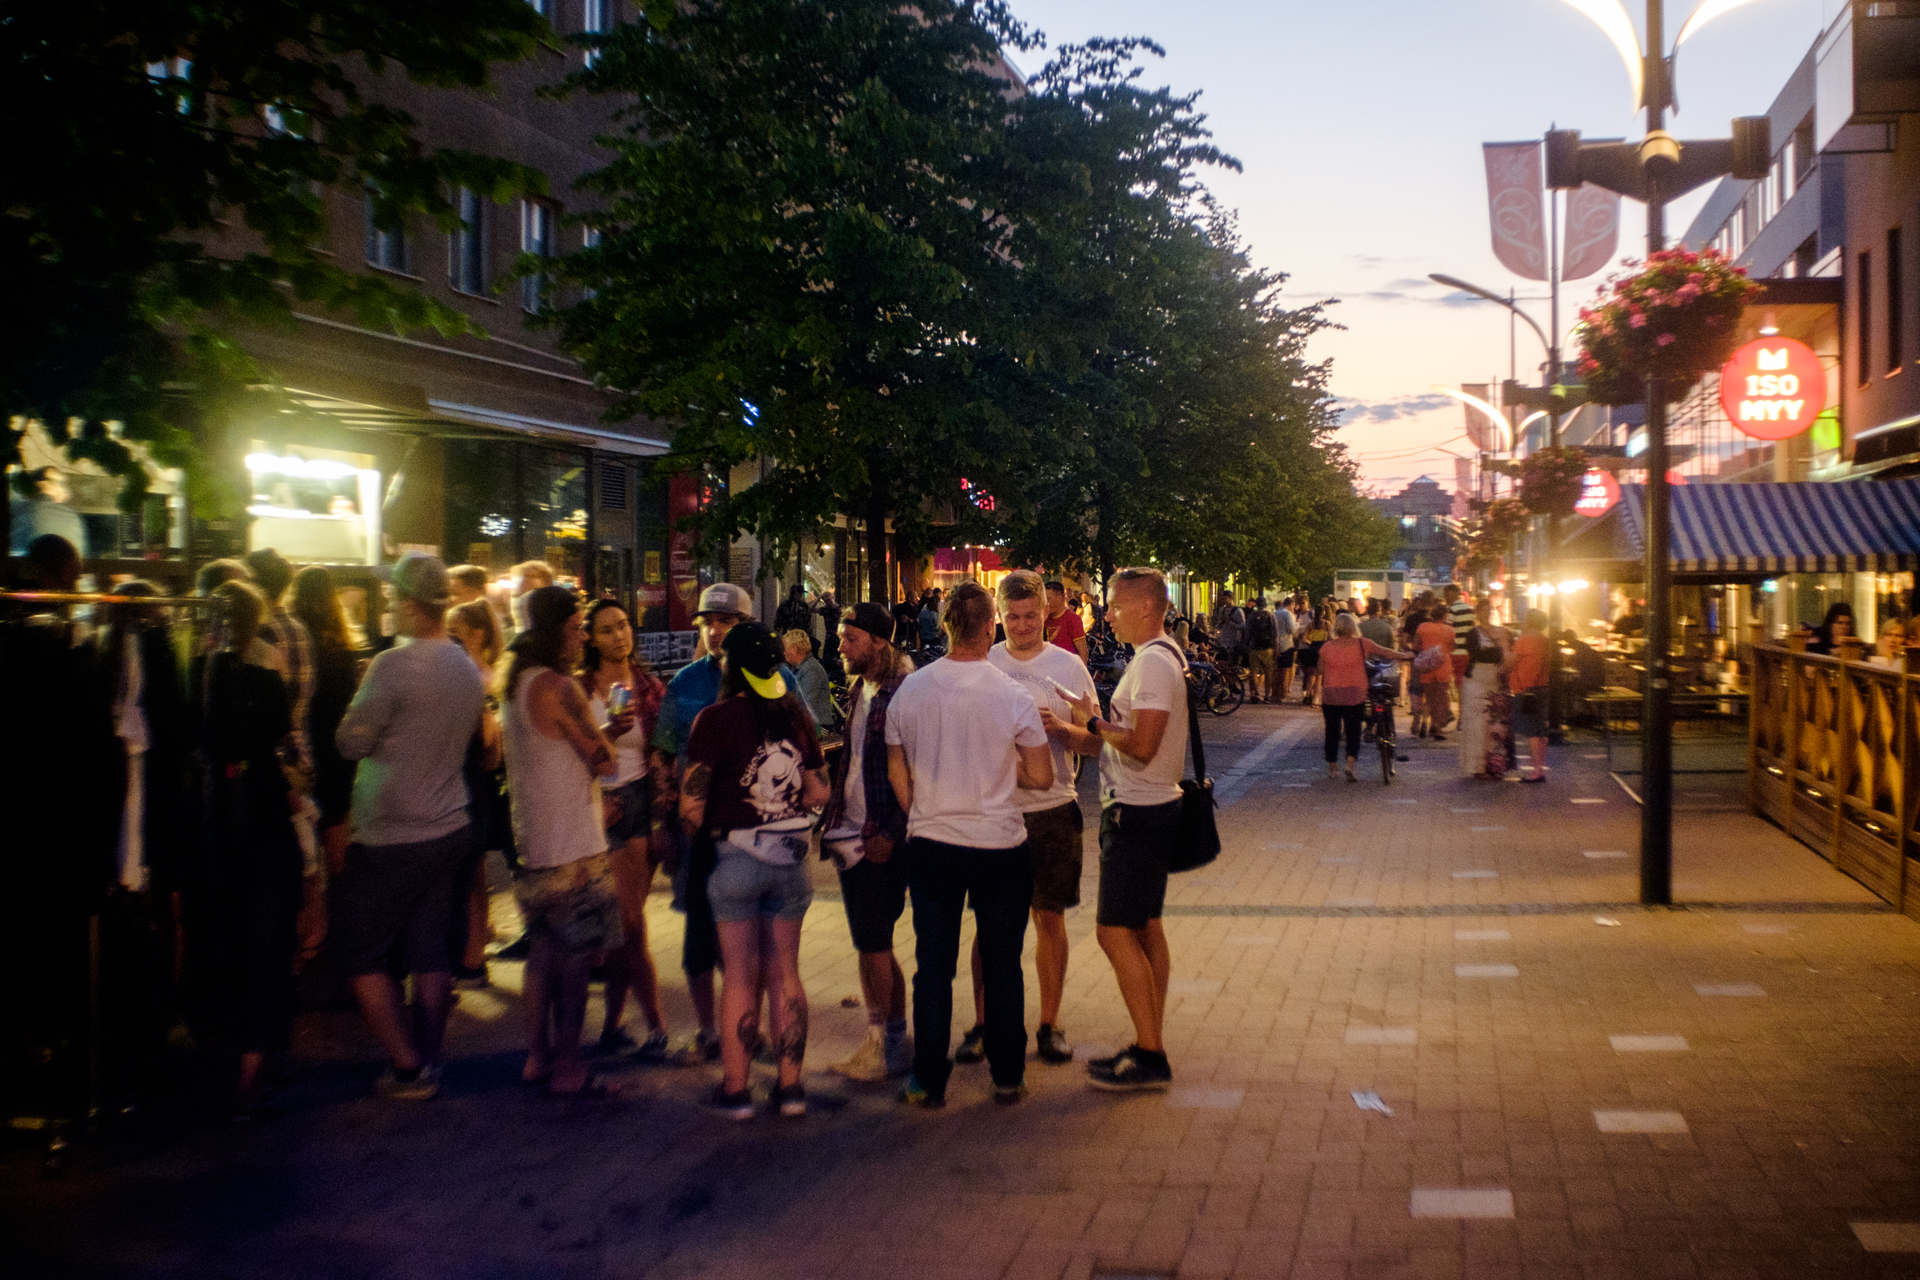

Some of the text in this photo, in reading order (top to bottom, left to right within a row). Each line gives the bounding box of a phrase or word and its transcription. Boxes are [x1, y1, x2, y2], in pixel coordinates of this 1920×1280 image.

[1758, 347, 1788, 370] M
[1746, 374, 1799, 396] ISO
[1740, 399, 1804, 420] MYY
